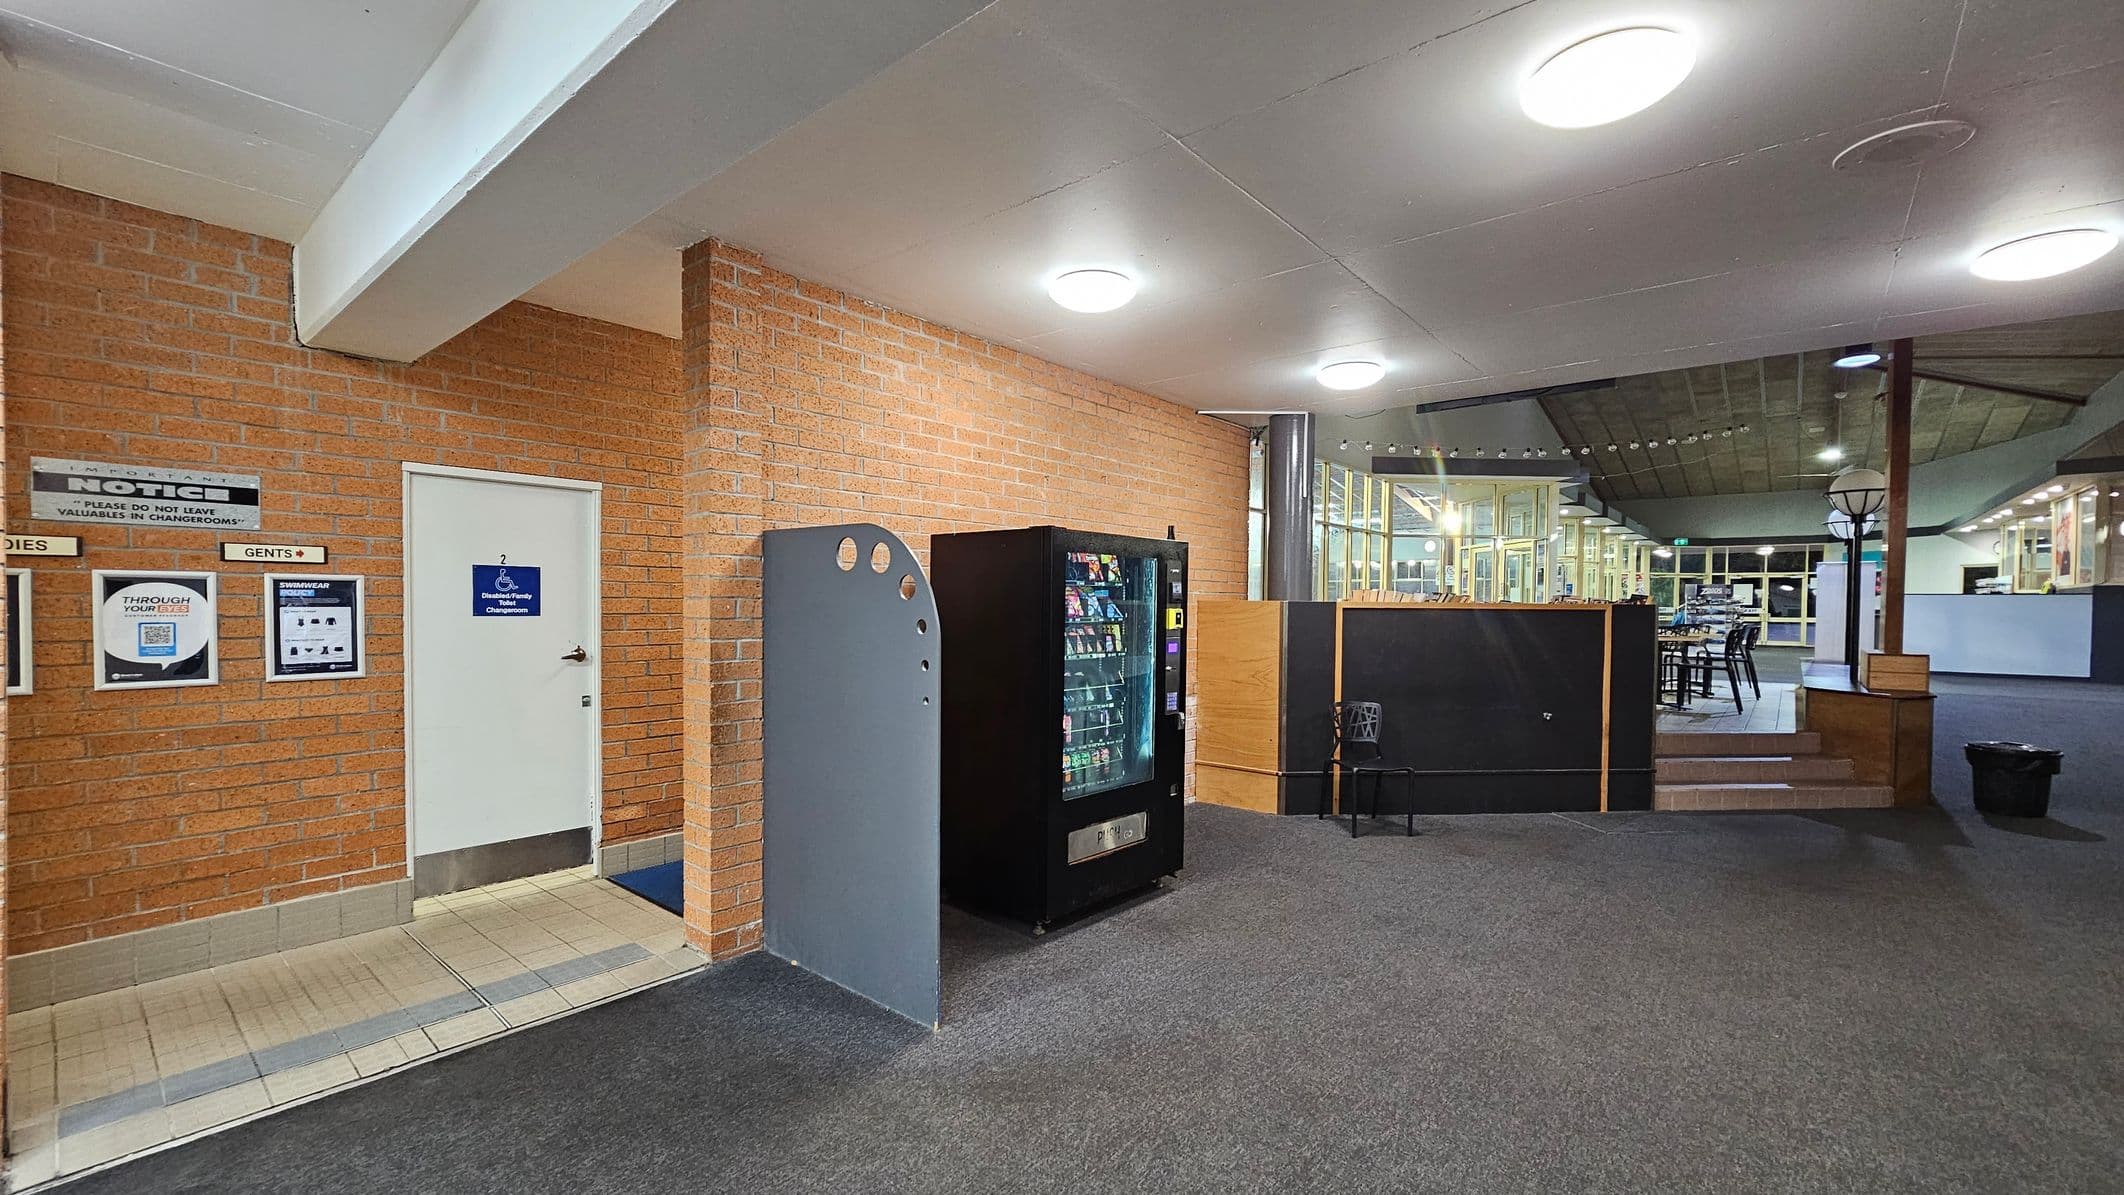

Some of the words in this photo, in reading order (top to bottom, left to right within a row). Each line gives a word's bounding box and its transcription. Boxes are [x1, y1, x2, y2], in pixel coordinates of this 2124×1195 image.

[69, 466, 227, 483] IMPORTANT
[67, 477, 230, 502] NOTICE
[57, 508, 126, 519] VALUABLES
[131, 512, 144, 520] IN
[132, 504, 150, 512] DO
[155, 505, 179, 513] NOT
[184, 507, 216, 516] LEAVE
[245, 547, 292, 559] GENTS
[500, 554, 507, 565] 2
[122, 596, 191, 605] THROUGH
[481, 592, 533, 601] Disabled/Family
[159, 605, 189, 613] EYES
[486, 606, 529, 614] Changeroom
